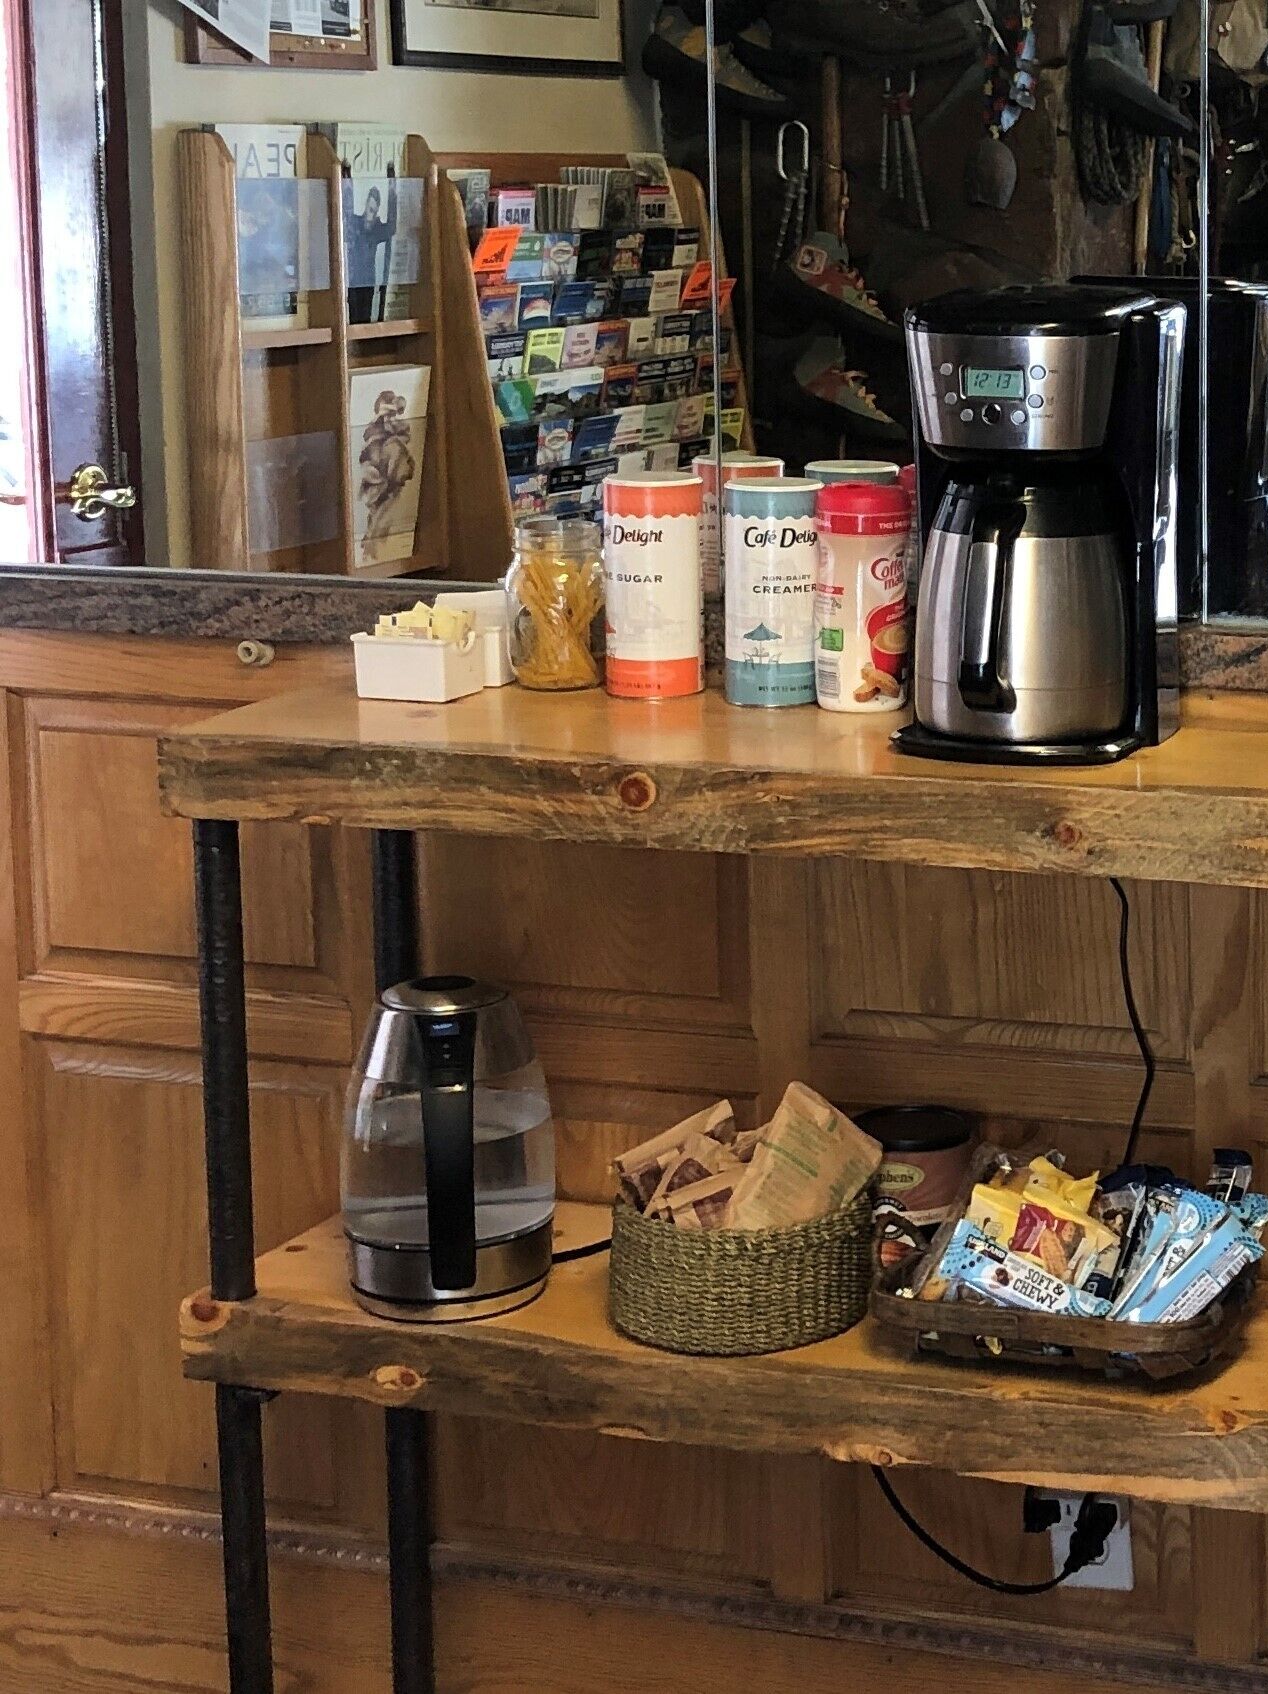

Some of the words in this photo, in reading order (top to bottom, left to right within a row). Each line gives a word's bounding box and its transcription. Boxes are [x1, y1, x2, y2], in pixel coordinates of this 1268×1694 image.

[613, 525, 664, 547] Delight
[744, 526, 777, 548] Café
[780, 527, 819, 549] Delig
[617, 573, 663, 583] SUGAR
[752, 583, 818, 595] CREAMER
[1024, 1267, 1054, 1291] SOFT
[1052, 1282, 1065, 1296] &
[1011, 1277, 1060, 1310] CHEWY
